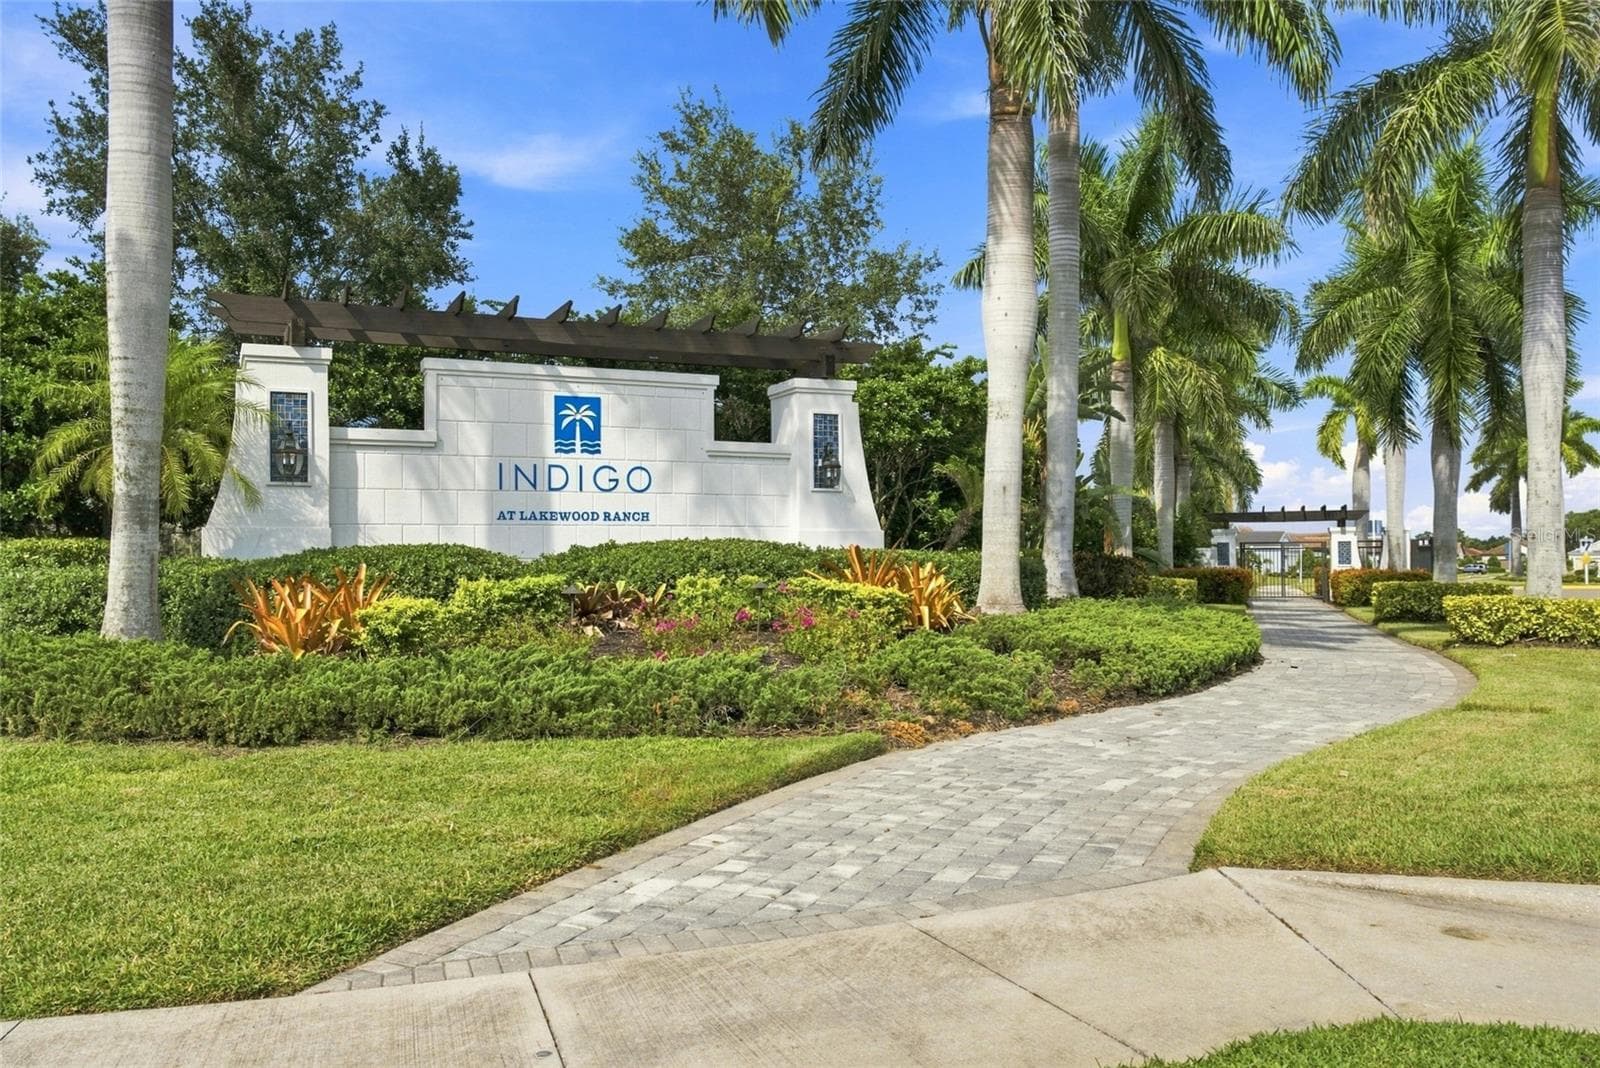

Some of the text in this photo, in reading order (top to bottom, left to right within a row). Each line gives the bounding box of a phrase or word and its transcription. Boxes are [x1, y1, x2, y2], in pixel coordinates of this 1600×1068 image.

[498, 462, 652, 493] INDIGO
[497, 511, 650, 522] AT LAKEWOOD RANCH
